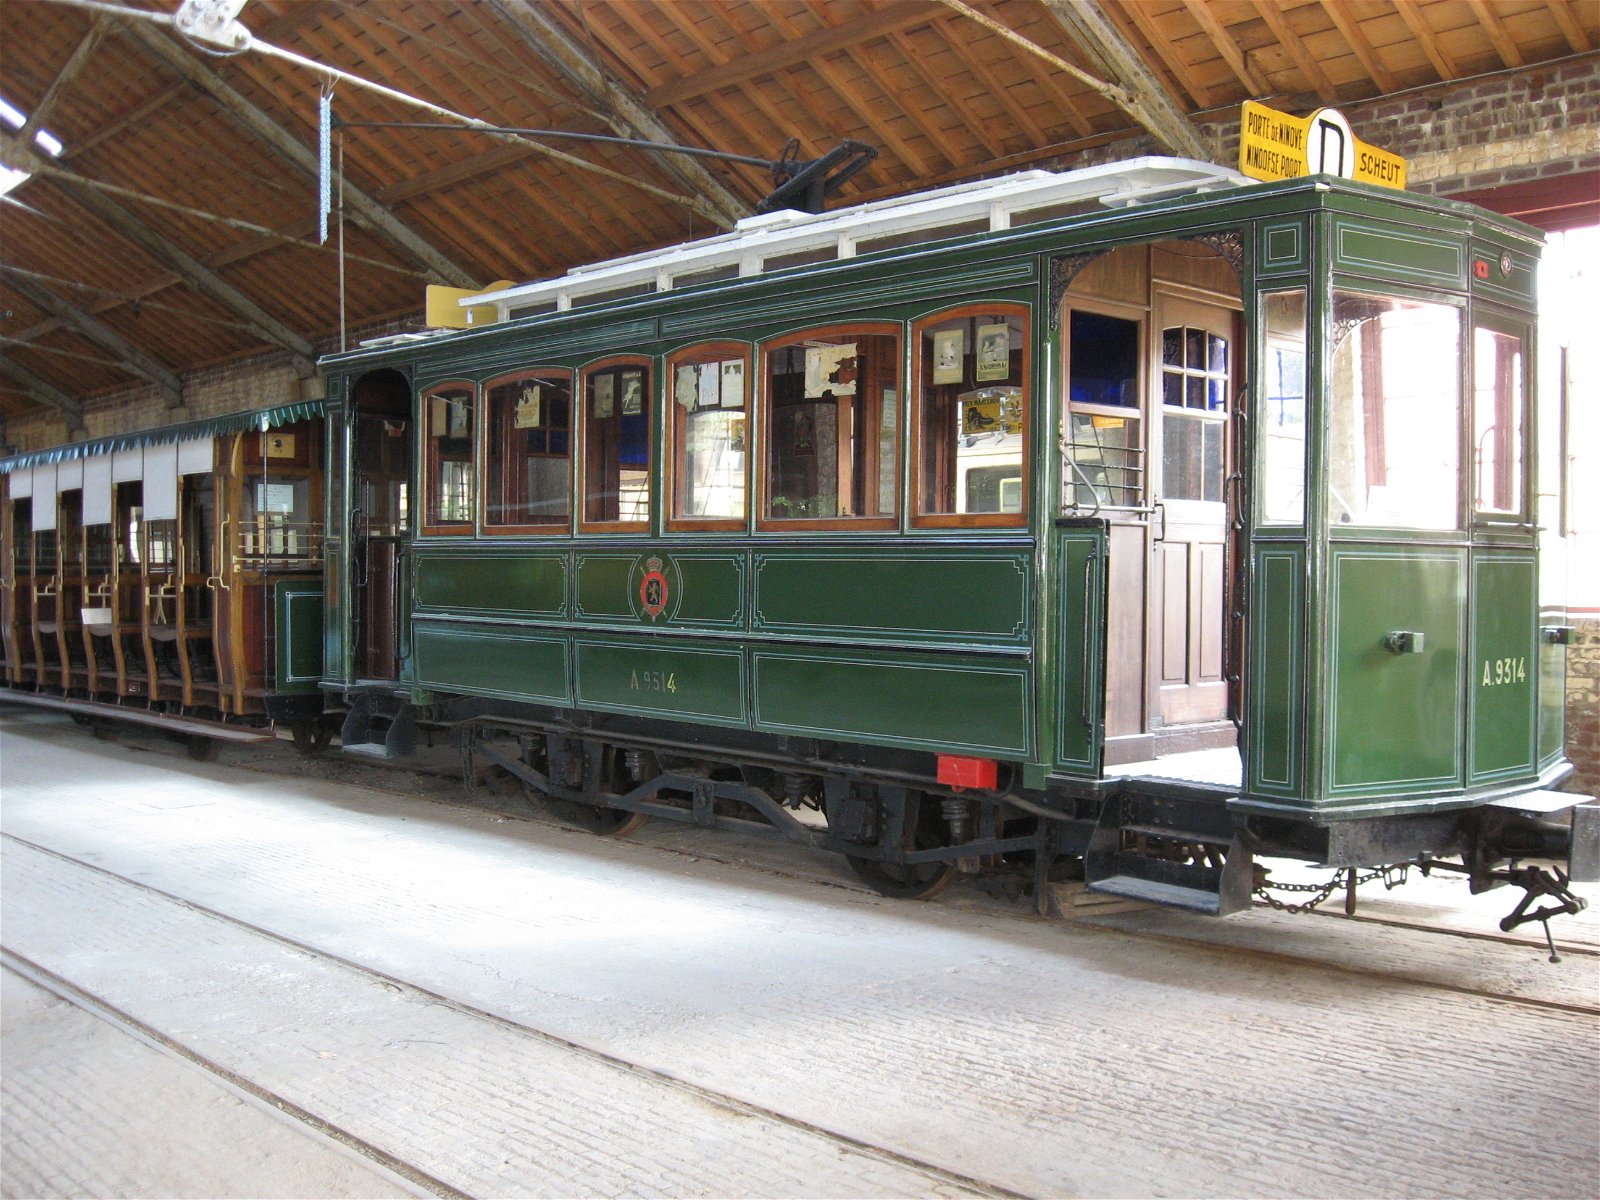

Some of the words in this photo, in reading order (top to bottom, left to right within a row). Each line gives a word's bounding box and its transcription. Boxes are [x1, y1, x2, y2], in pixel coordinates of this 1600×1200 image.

[1247, 111, 1270, 140] PORTE
[1279, 122, 1303, 151] NINOVE
[1246, 143, 1280, 175] NINOOFSE
[1280, 155, 1302, 178] POORT
[1359, 152, 1401, 184] SCHEUT
[1482, 656, 1526, 687] A.9314
